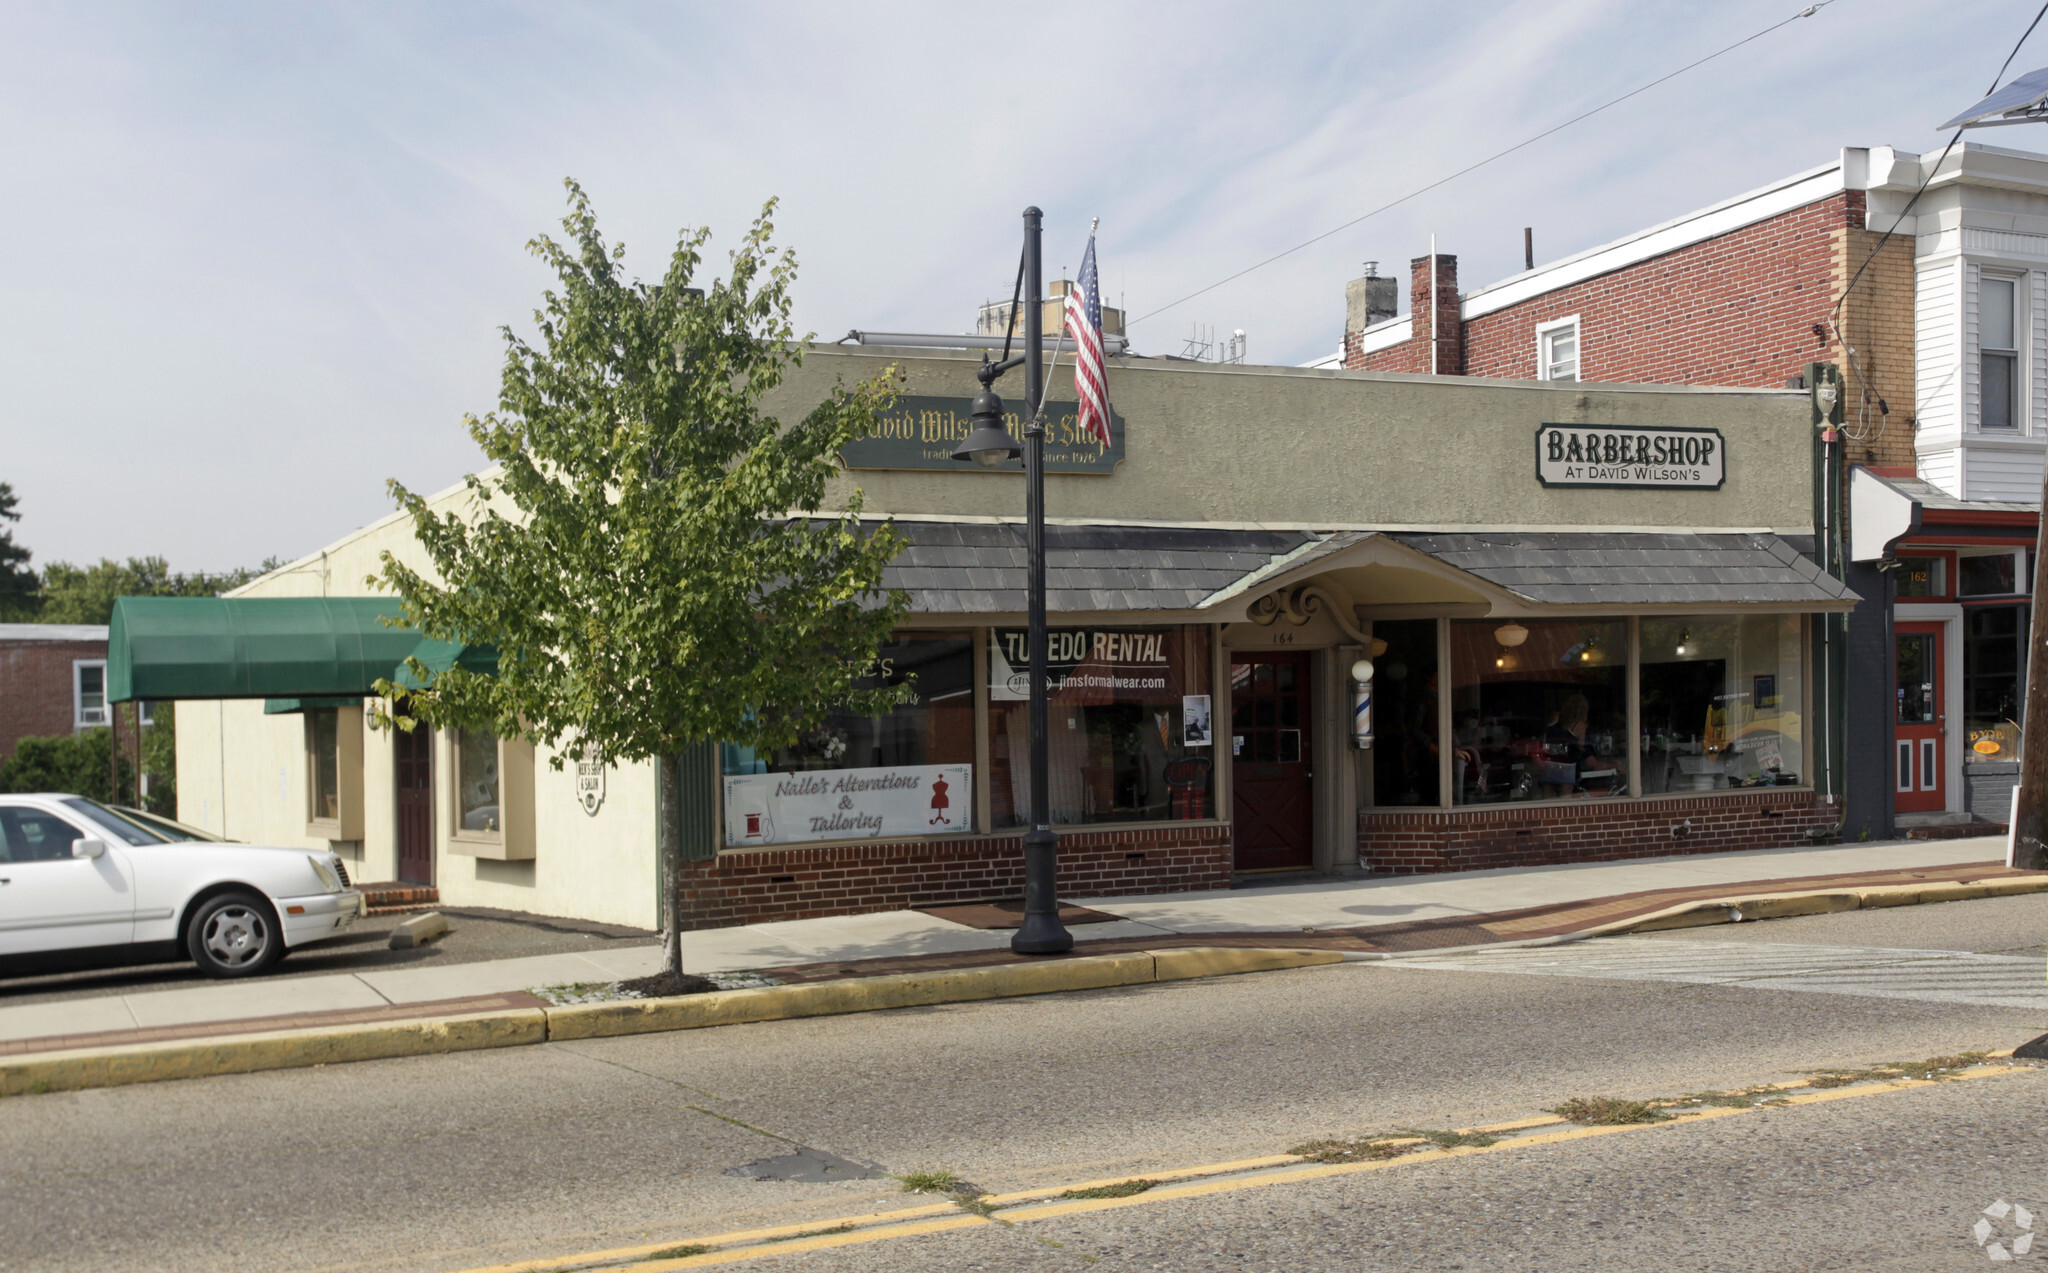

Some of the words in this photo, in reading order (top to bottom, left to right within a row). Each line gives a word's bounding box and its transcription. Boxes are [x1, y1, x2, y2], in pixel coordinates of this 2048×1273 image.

[856, 410, 913, 441] avid
[919, 409, 974, 443] Wils
[1547, 430, 1715, 466] BARBERSHOP
[1072, 452, 1096, 464] 1976
[1565, 466, 1583, 478] AT
[1589, 467, 1629, 480] DAVID
[1634, 468, 1700, 481] WILSON'S
[1910, 571, 1927, 583] 162
[1273, 633, 1293, 643] 164
[1005, 632, 1085, 662] TUEDO
[1093, 632, 1167, 662] RENTAL
[1059, 674, 1165, 690] jimsformalwear.com
[1969, 729, 2005, 741] BYOB
[832, 772, 921, 794] Alterations
[839, 795, 854, 810] &
[809, 812, 883, 836] Tailoring
